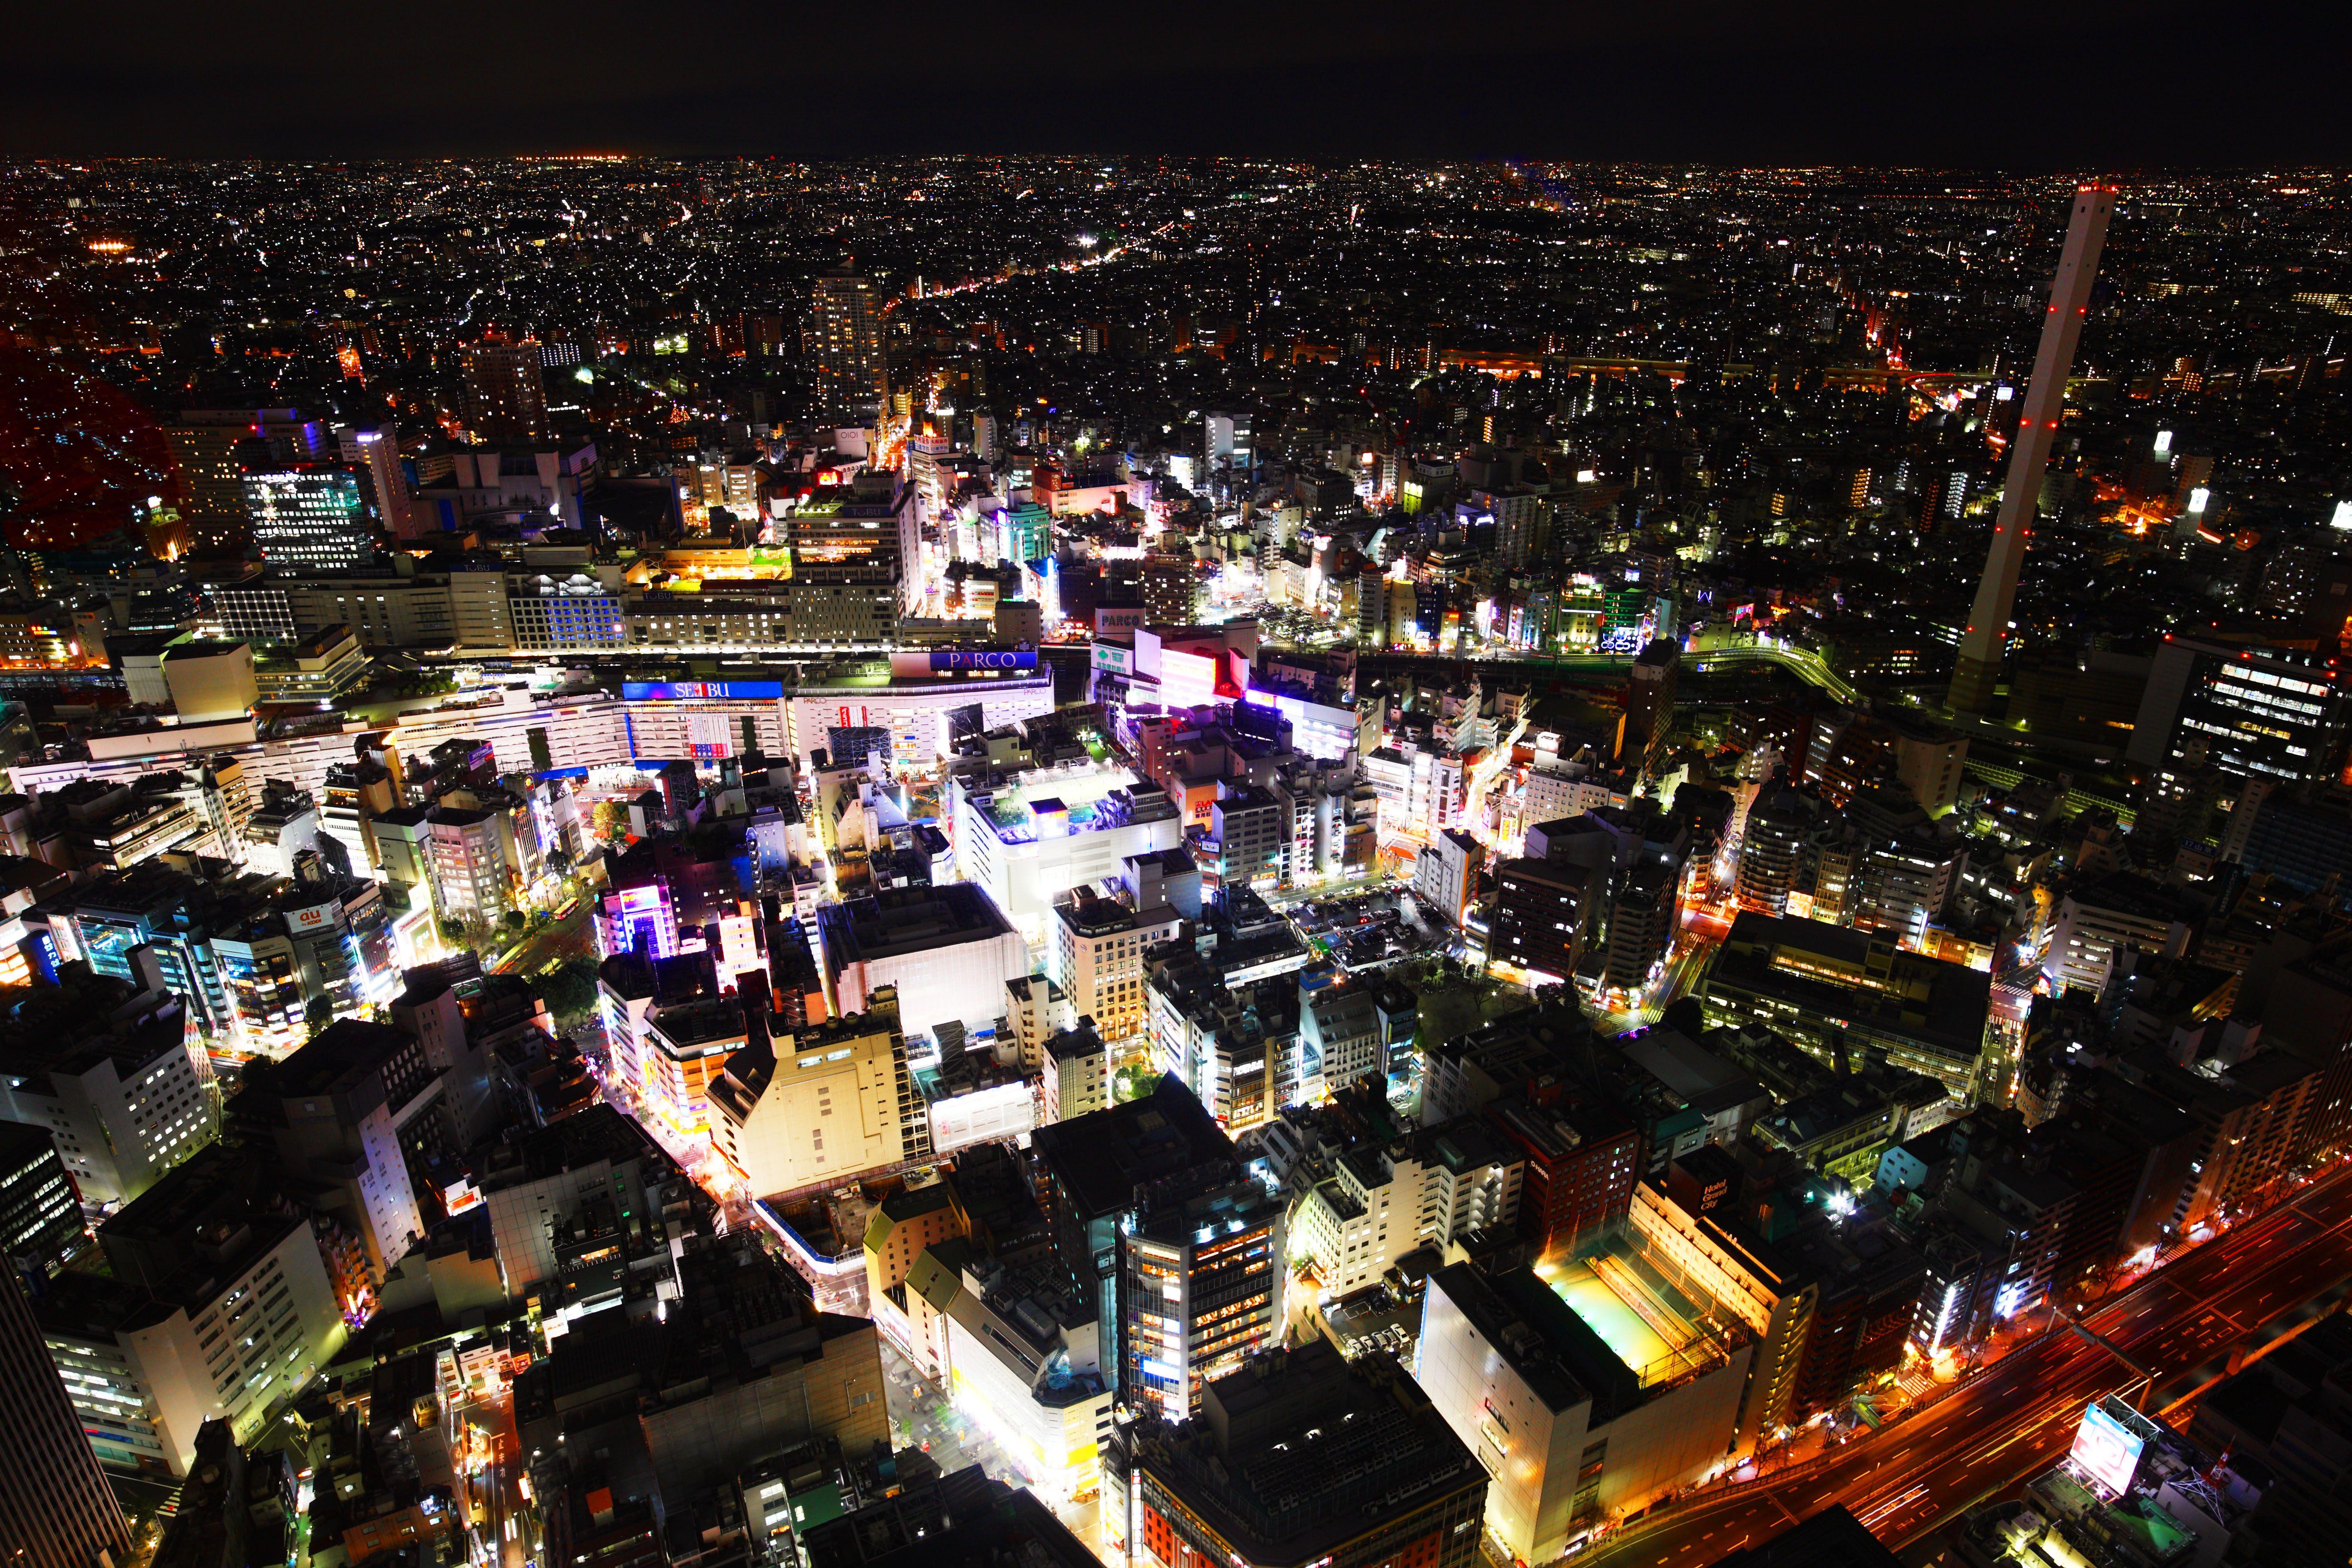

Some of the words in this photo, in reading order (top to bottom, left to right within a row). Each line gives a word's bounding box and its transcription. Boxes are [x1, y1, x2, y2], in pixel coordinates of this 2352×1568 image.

[644, 592, 671, 600] TOBU
[1102, 615, 1139, 626] PARCO
[950, 653, 1017, 668] PARCO
[1097, 662, 1126, 673] 住友信託銀行
[675, 683, 730, 698] SEIBU
[300, 910, 321, 921] au
[877, 1003, 894, 1011] シネマ
[1704, 1179, 1726, 1195] Hotel
[1702, 1186, 1728, 1203] Grand
[1701, 1200, 1718, 1211] City
[1002, 1238, 1019, 1248] ホテル
